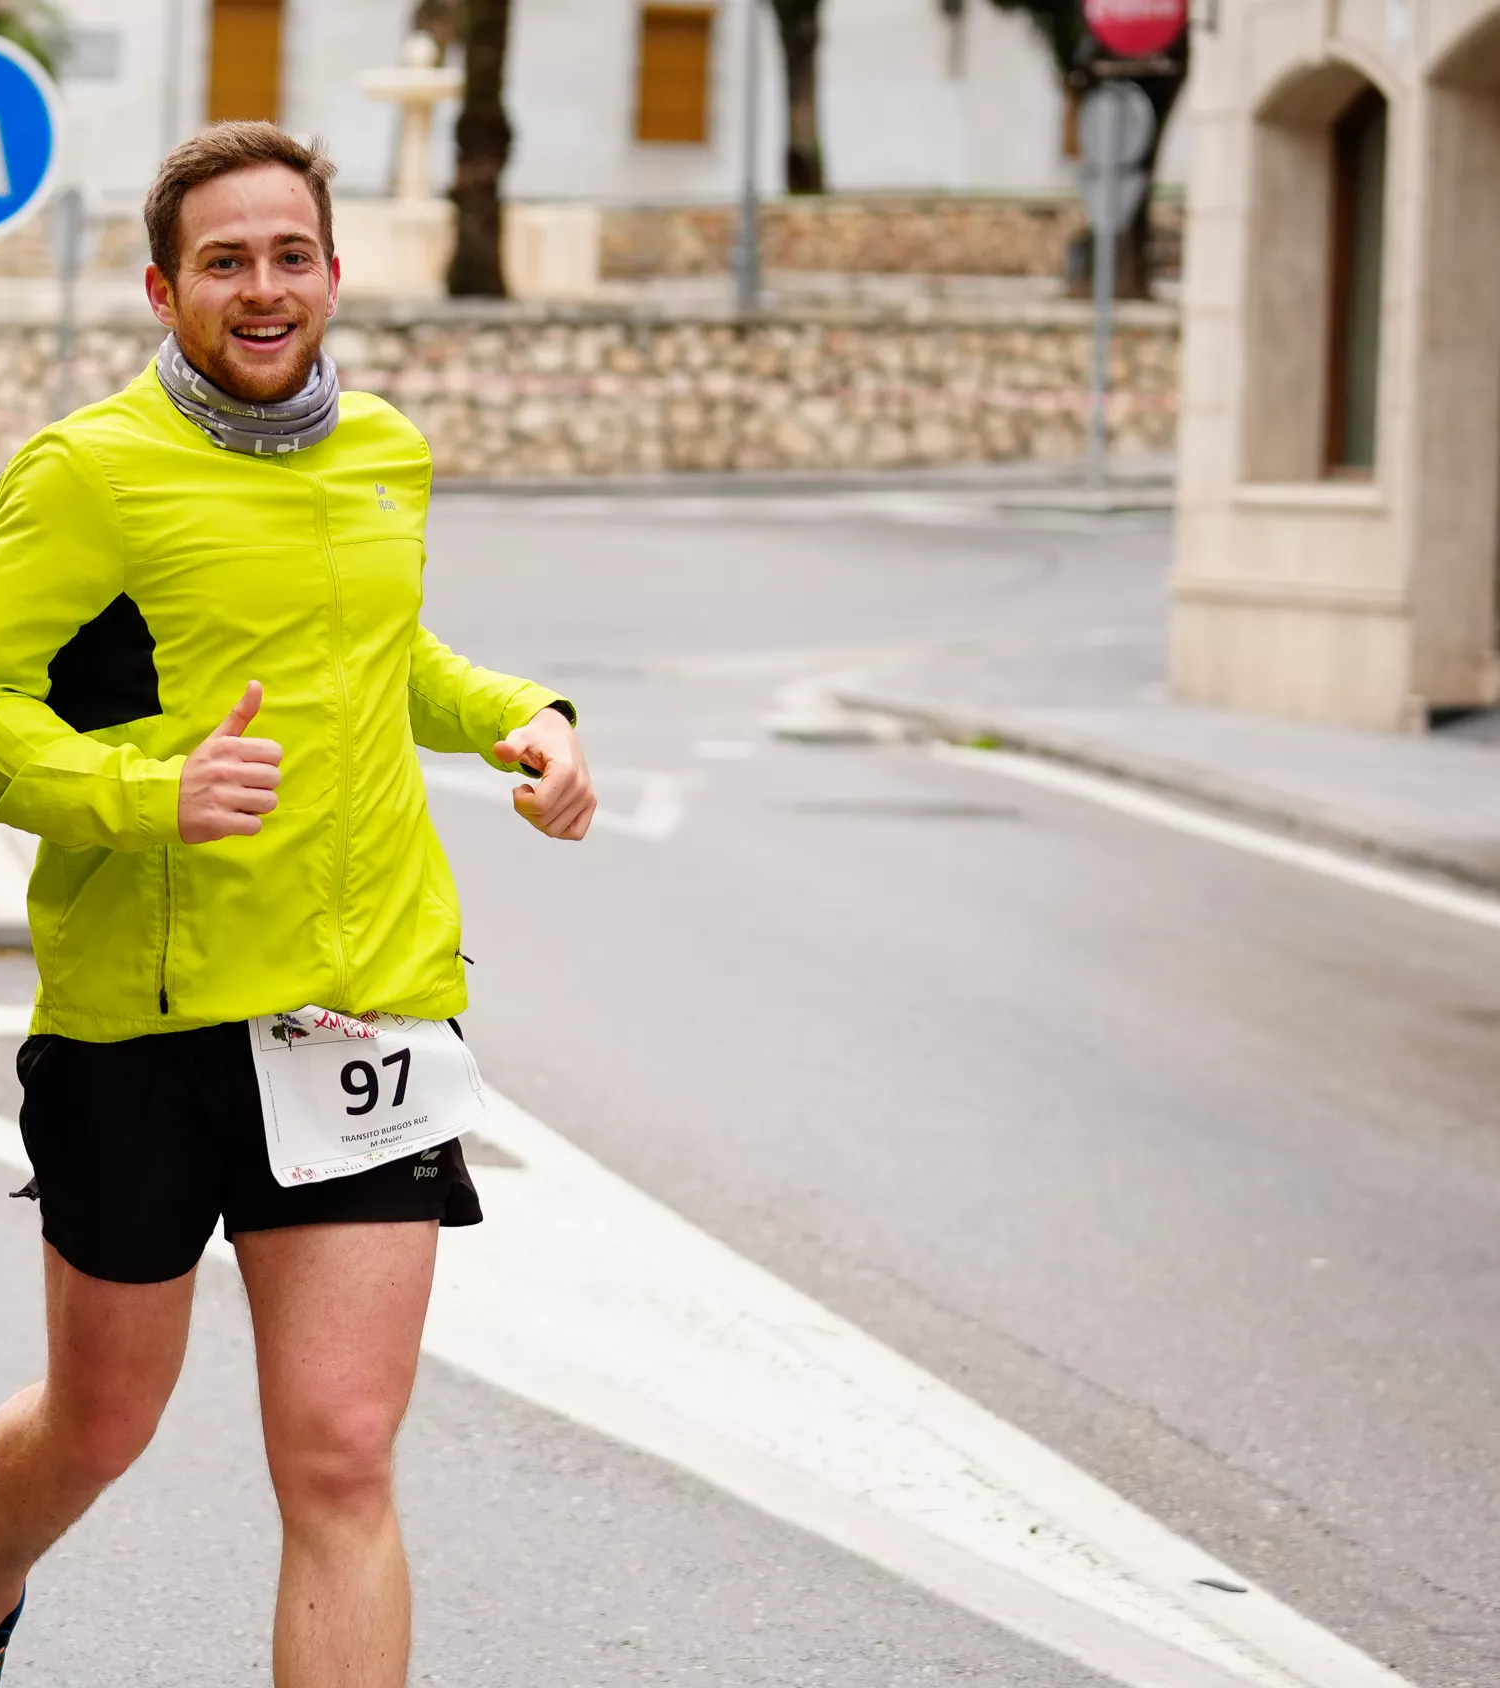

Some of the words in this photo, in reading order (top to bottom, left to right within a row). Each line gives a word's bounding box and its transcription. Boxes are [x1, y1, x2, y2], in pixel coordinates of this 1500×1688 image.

[340, 1047, 411, 1116] 97
[340, 1129, 380, 1143] TRANSITO
[381, 1120, 412, 1135] BURGOS
[413, 1115, 429, 1126] RUZ
[370, 1135, 403, 1148] M-Mujer
